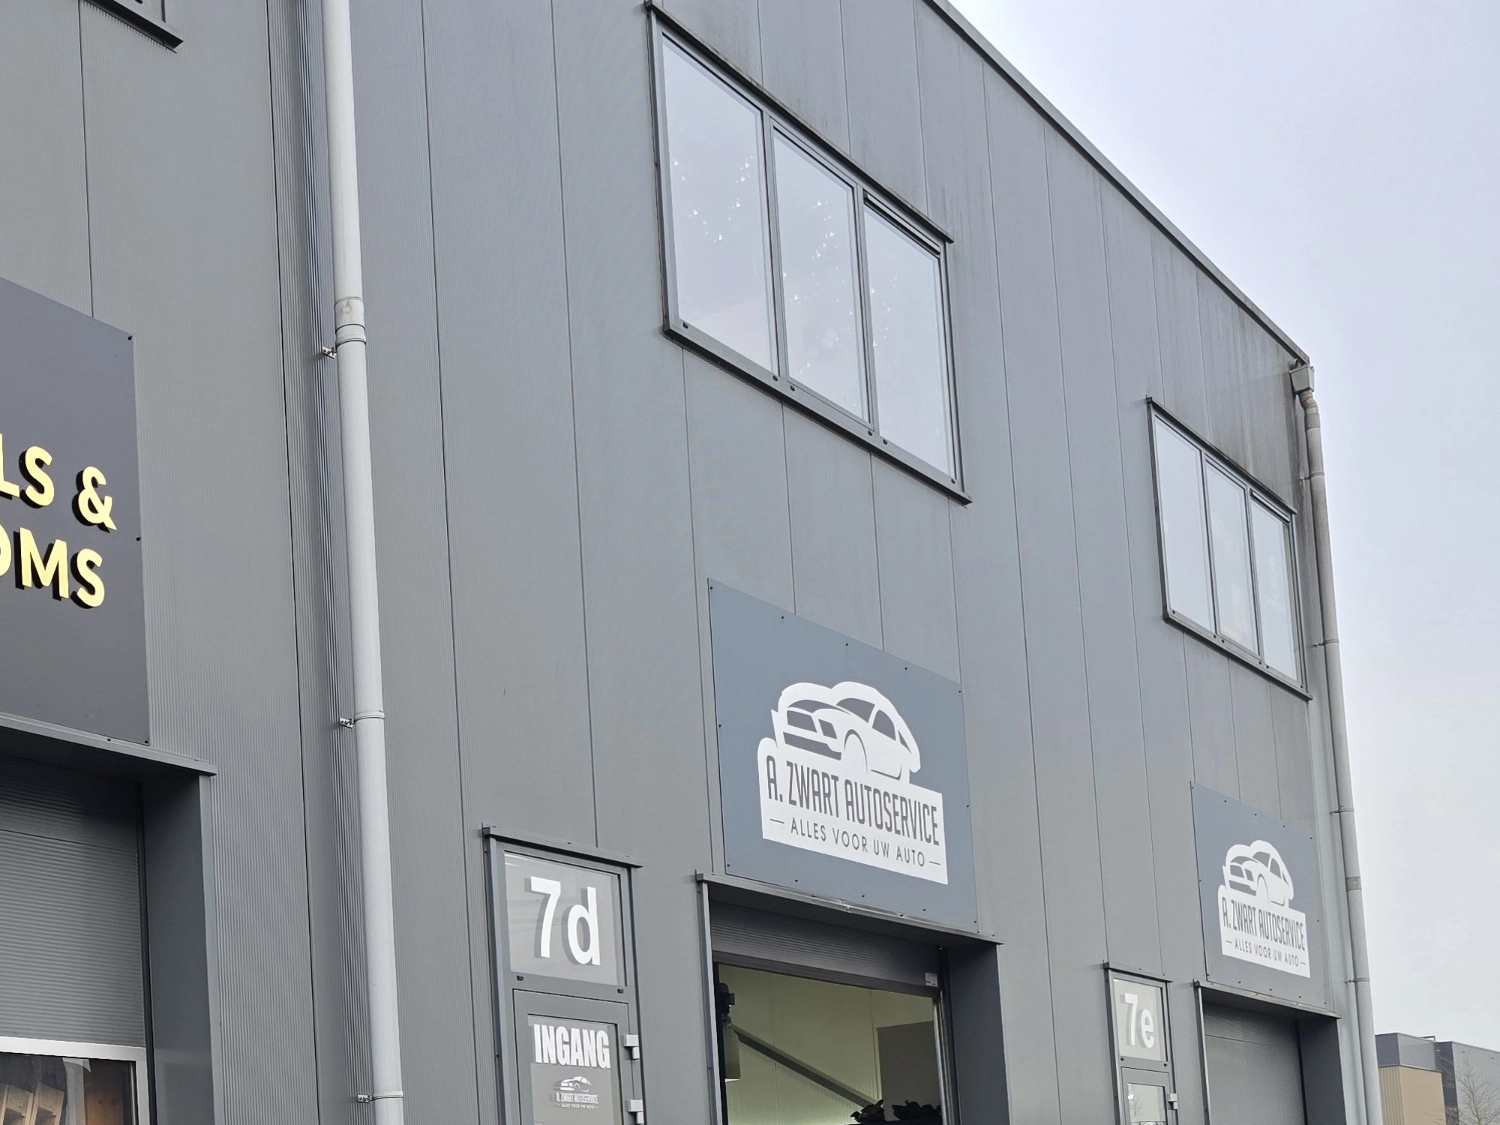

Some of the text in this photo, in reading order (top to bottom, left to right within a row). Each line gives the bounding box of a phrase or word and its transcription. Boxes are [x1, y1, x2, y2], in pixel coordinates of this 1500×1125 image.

[79, 466, 117, 531] &
[766, 755, 939, 846] A. ZWART AUTOSERVICE
[790, 816, 925, 867] ALLES VOOR UW AUTO
[530, 875, 601, 966] 7d
[1231, 899, 1258, 936] ZWART
[1258, 908, 1306, 951] AUTOSERVICE
[1234, 938, 1252, 954] ALLES
[1254, 944, 1271, 959] VOOR
[1284, 953, 1299, 967] AUTO
[533, 1023, 611, 1069] INGANG
[1124, 992, 1155, 1049] 7e
